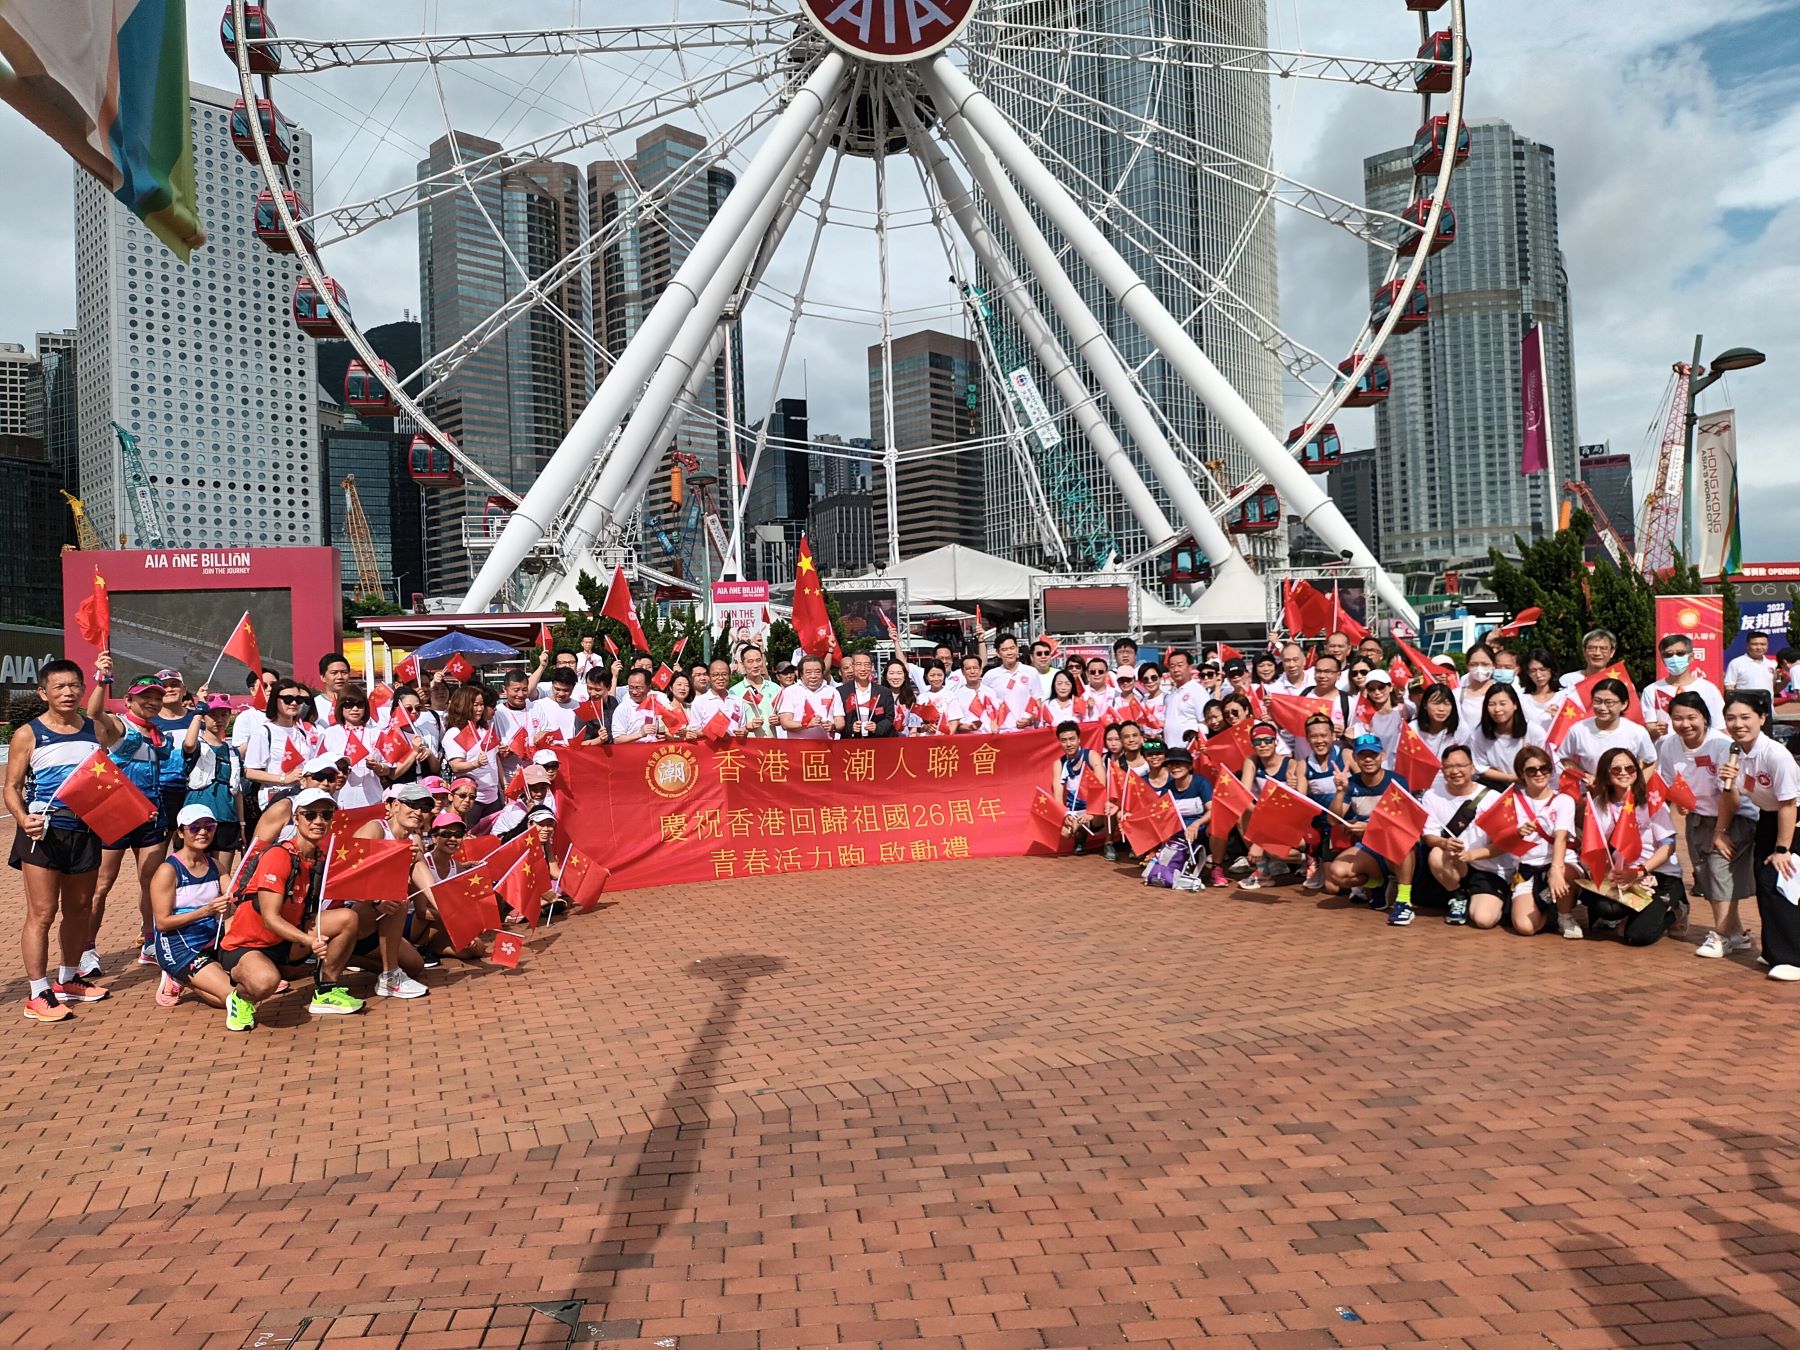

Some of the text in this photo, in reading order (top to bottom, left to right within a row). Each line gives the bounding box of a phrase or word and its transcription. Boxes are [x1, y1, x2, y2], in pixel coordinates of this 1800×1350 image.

[824, 0, 954, 44] AIA
[1707, 448, 1722, 534] HONG KONG
[145, 554, 168, 568] AIA
[717, 587, 728, 595] AIA
[1751, 583, 1777, 596] 06
[740, 609, 755, 618] THE
[1766, 603, 1785, 612] 2023
[720, 619, 756, 628] JURNEY
[0, 655, 38, 684] AIA
[657, 760, 686, 784] 潮
[712, 742, 1001, 784] 香港區潮人聯會
[659, 796, 1006, 843] 慶祝香港回歸祖國26周年
